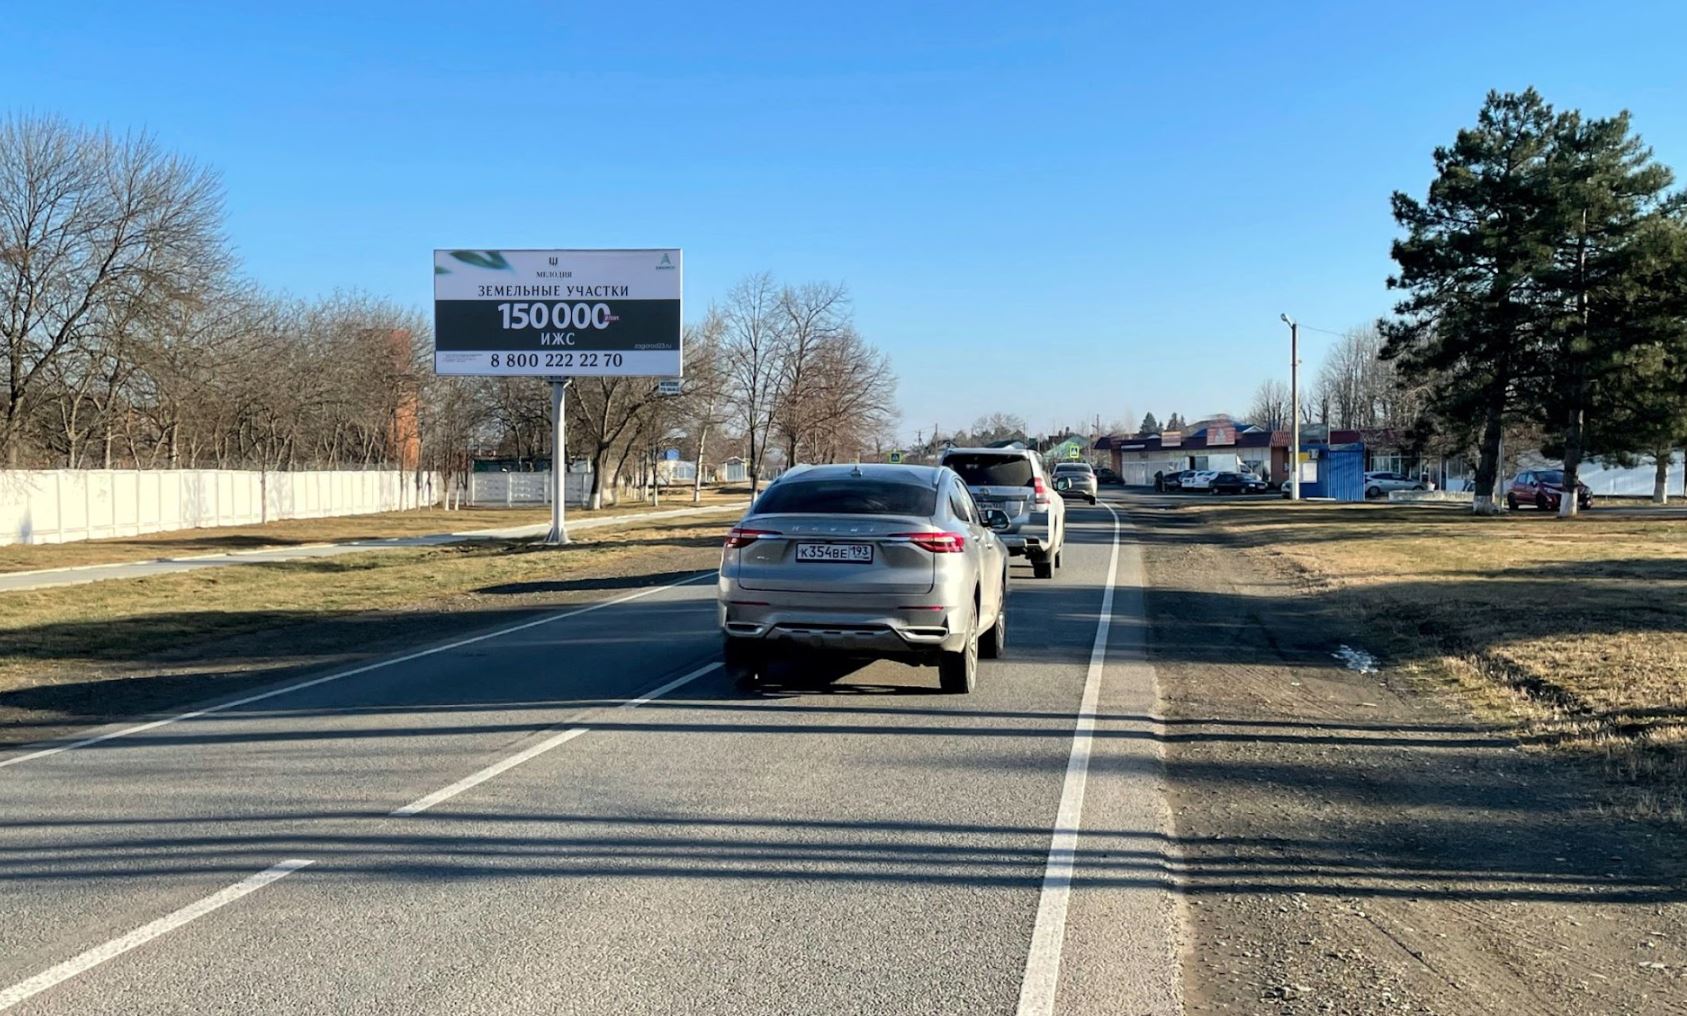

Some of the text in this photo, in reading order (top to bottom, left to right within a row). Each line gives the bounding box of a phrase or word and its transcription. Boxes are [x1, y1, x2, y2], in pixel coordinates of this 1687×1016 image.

[478, 285, 629, 297] ЗЕМЕЛЬНЫЕ УЧАСТКИ
[541, 332, 575, 346] ИЖС
[491, 353, 500, 368] 8
[506, 353, 539, 368] 800
[545, 353, 573, 368] 222
[579, 353, 598, 368] 22
[604, 353, 622, 368] 70
